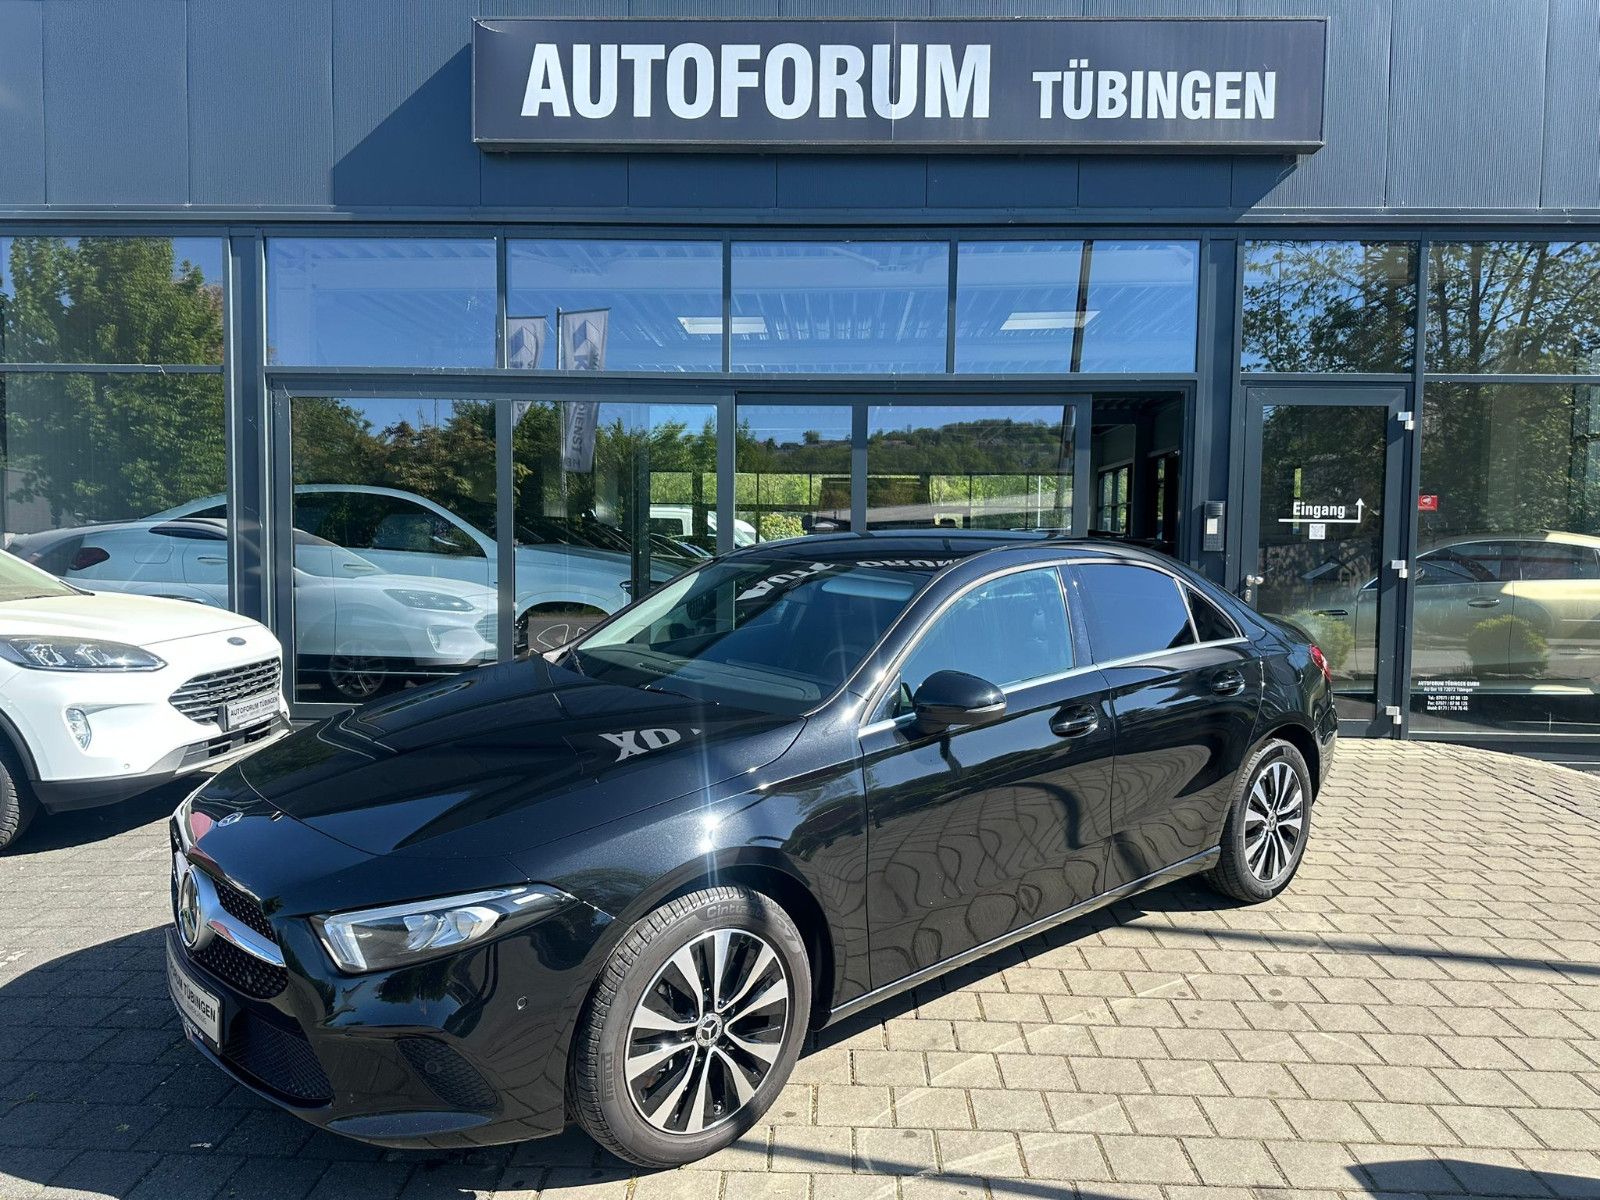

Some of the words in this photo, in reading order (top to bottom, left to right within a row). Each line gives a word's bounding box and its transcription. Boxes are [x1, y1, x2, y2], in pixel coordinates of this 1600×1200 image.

[520, 42, 991, 120] AUTOFORUM
[1031, 58, 1276, 121] TÜBINGEN
[1292, 501, 1346, 519] Eingang
[230, 702, 259, 716] AUTOFORUM
[183, 982, 216, 1022] TÜBINGEN
